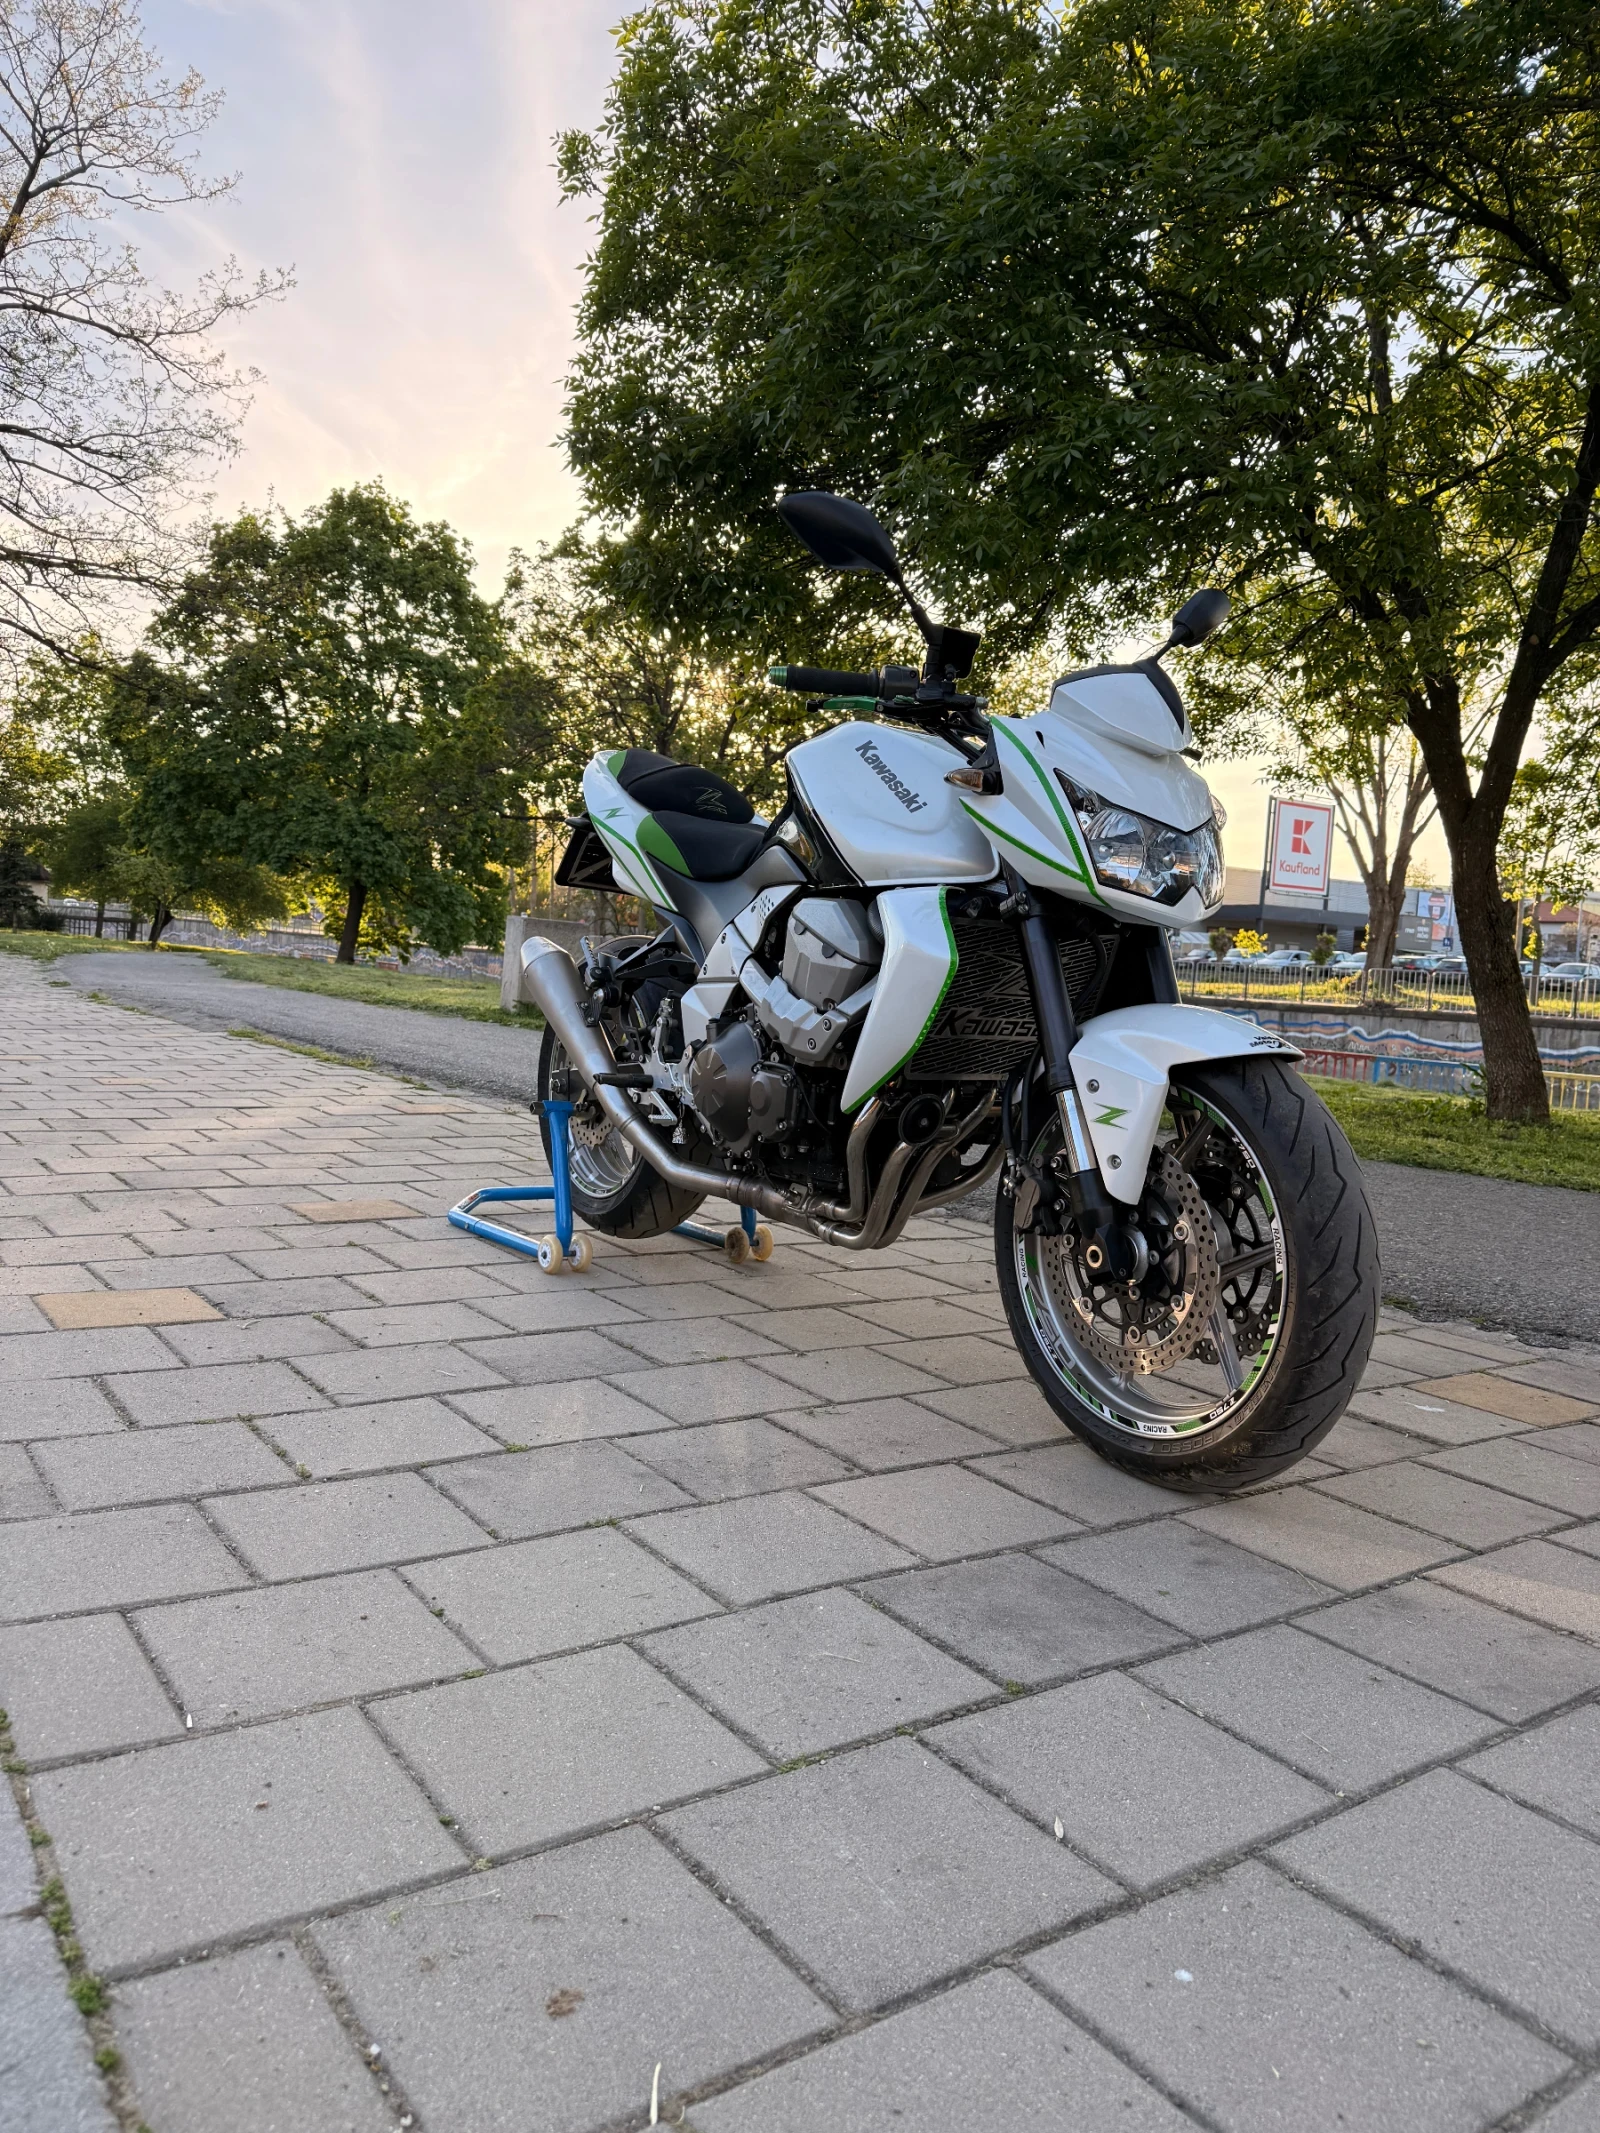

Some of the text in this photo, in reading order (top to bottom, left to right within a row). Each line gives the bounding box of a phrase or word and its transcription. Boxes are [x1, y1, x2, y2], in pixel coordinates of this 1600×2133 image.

[855, 740, 928, 814] Kawasaki
[1279, 860, 1320, 876] Kaufland
[934, 1008, 1039, 1037] Kawas
[1272, 1227, 1284, 1265] RACING
[1018, 1248, 1028, 1278] RACING
[1209, 1396, 1236, 1420] Z750
[1142, 1424, 1168, 1434] RACING
